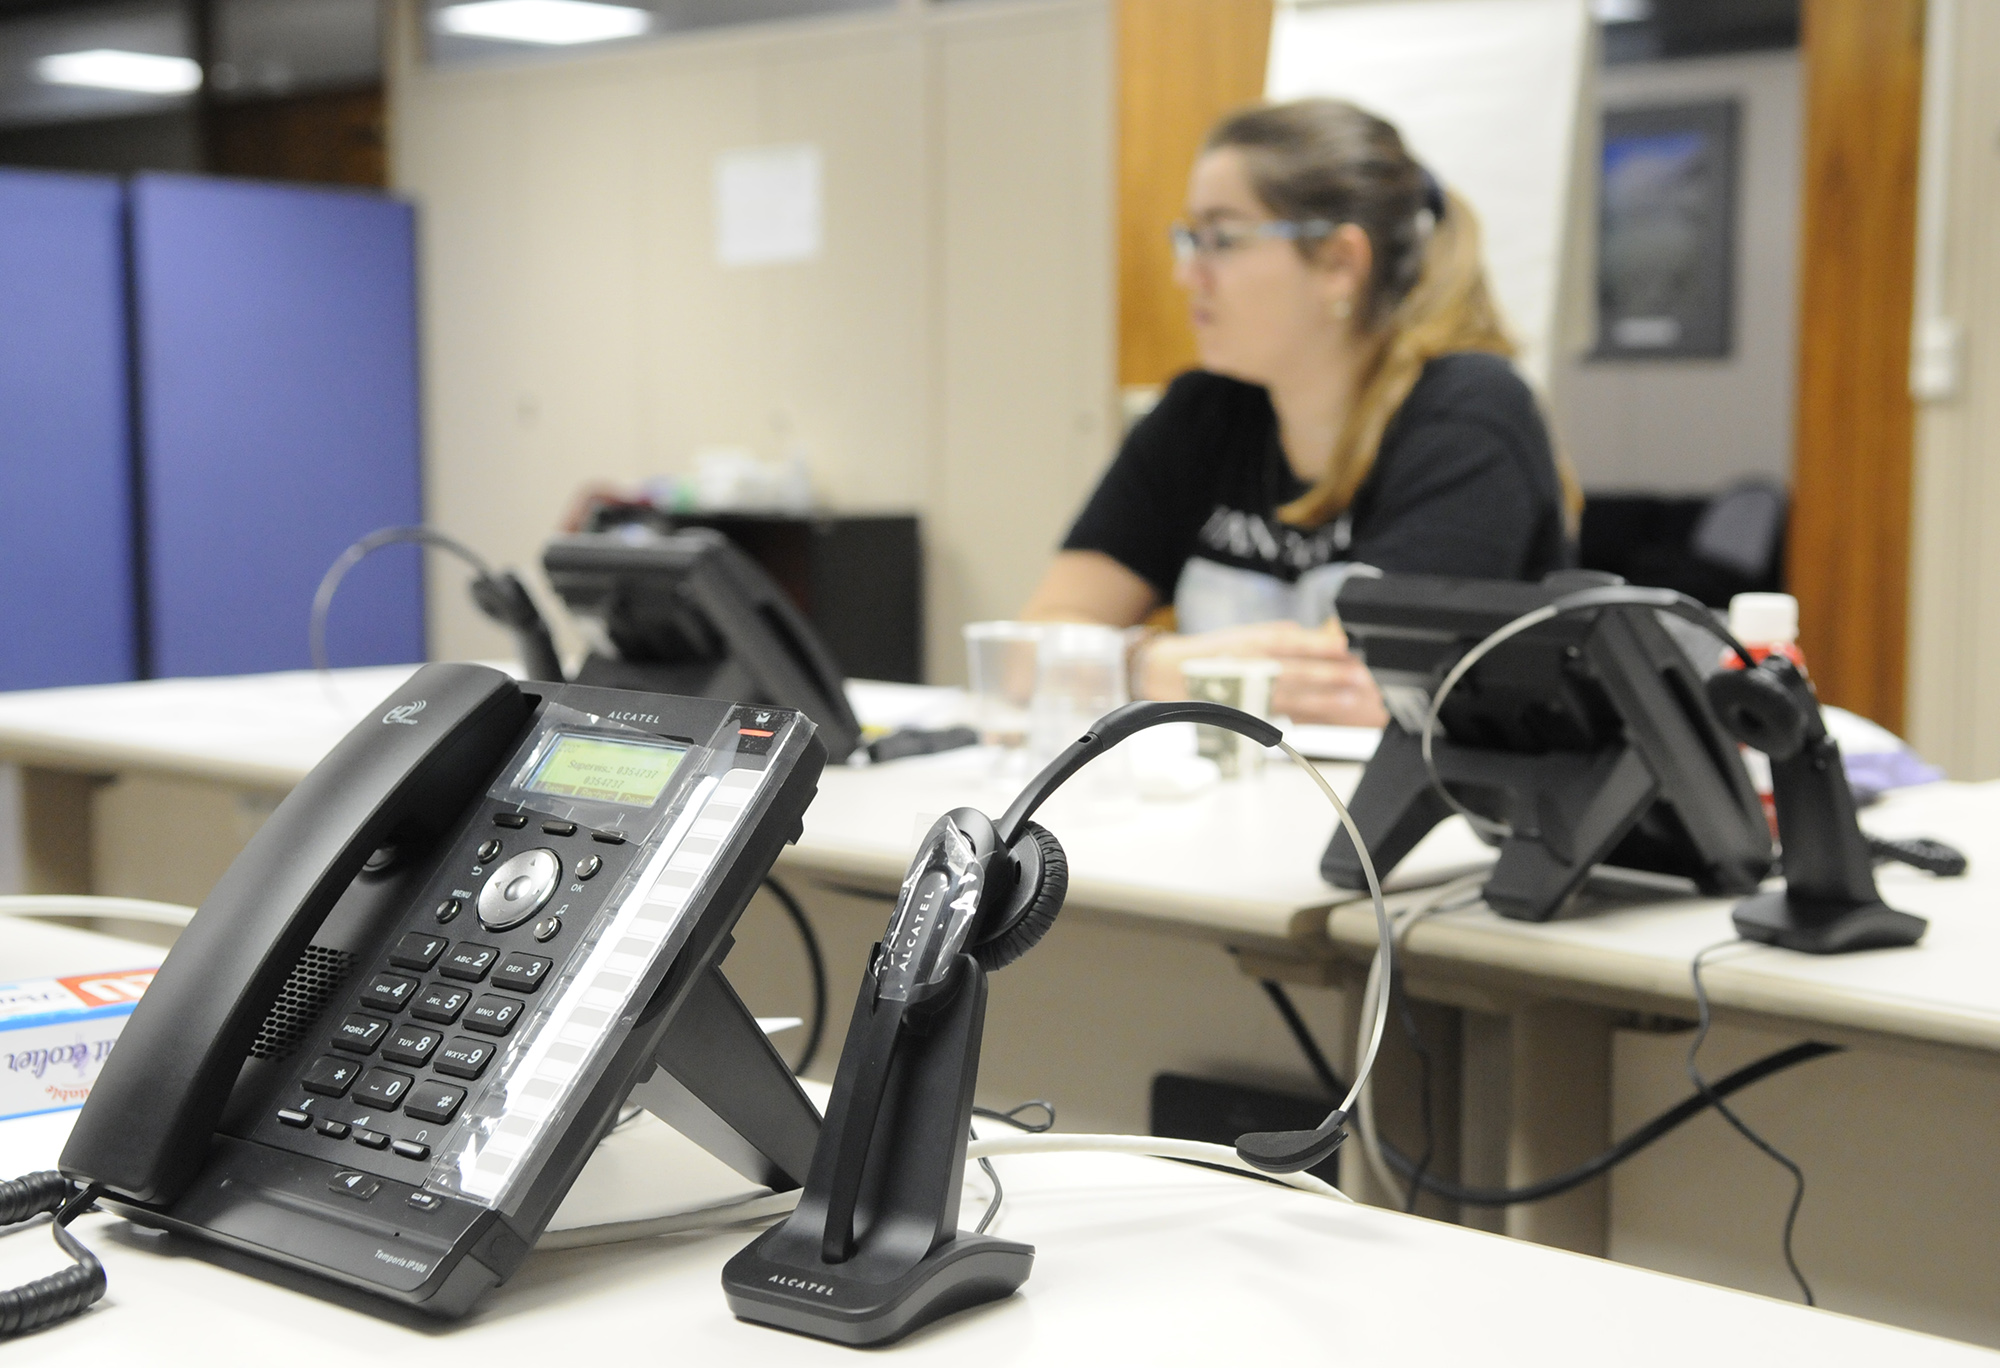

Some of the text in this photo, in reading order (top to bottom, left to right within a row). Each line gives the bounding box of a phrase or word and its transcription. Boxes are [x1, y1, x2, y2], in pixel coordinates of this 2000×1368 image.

[608, 710, 660, 724] ALCATEL
[452, 889, 472, 899] MENU
[571, 884, 584, 892] OK
[899, 891, 935, 972] ALCATEL
[424, 942, 434, 955] 1
[454, 952, 489, 967] ABC 2
[506, 962, 540, 976] DEF 3
[376, 983, 404, 996] GHI 4
[426, 995, 460, 1009] JKL 5
[476, 1006, 510, 1020] MNO 6
[342, 1023, 380, 1038] PQRS 7
[398, 1036, 429, 1051] TUV 8
[4, 1042, 87, 1079] écolier
[445, 1049, 482, 1064] WXYZ 9
[386, 1082, 400, 1096] 0
[438, 1096, 452, 1108] #
[374, 1249, 406, 1266] Temporis
[768, 1274, 834, 1296] ALCATEL
